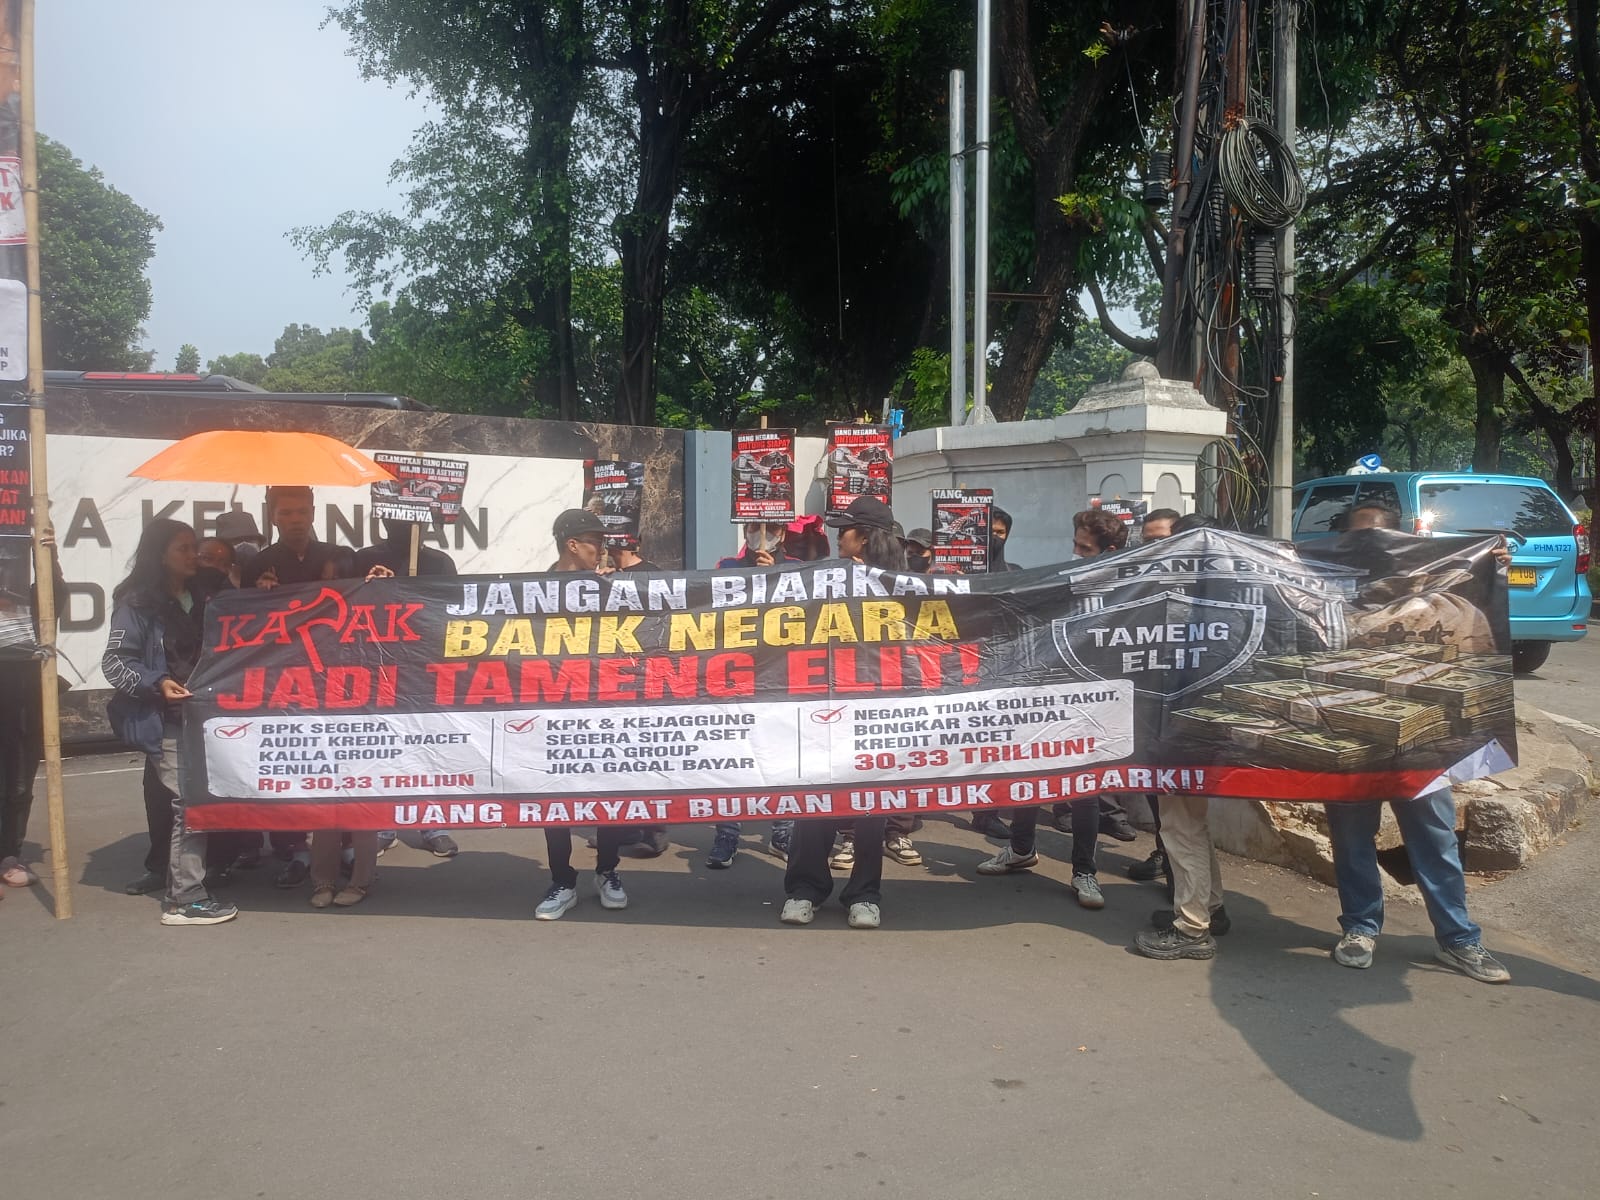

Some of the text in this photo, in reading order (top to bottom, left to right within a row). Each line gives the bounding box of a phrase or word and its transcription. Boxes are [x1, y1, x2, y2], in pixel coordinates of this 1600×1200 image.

[377, 455, 421, 465] SELAMATKAN
[422, 458, 440, 467] UANG
[441, 460, 467, 470] RAKYAT
[594, 464, 615, 472] UANG
[933, 490, 962, 499] UANG
[1116, 558, 1218, 579] BANK
[446, 564, 971, 616] JANGAN BIARKAN
[443, 600, 960, 659] BANK NEGARA
[1087, 621, 1230, 648] TAMENG
[1122, 646, 1208, 674] ELIT
[216, 643, 981, 711] JADI TAMENG ELIT!
[854, 704, 929, 722] NEGARA
[934, 699, 991, 716] TIDAK
[996, 695, 1056, 711] BOLEH
[261, 721, 390, 735] BPK SEGERA
[547, 713, 756, 731] KPK & KEJAGGUNG
[854, 709, 1072, 737] BONGKAR SKANDAL
[259, 733, 472, 748] AUDIT KREDIT MACET
[546, 729, 750, 746] SEGERA SITA ASET
[854, 729, 1016, 751] KREDIT MACET
[259, 749, 403, 762] KALLA GROUP
[546, 745, 699, 760] KALLA GROUP
[853, 736, 1097, 772] 30,33 TRILIUN!
[258, 763, 340, 775] SENILAI
[545, 757, 755, 775] JIKA GAGAL BAYAR
[257, 774, 475, 793] Rp 30,33 TRILIUN
[394, 767, 1205, 825] UANG RAKYAT BUKAN UNTUK OLIGARKI!
